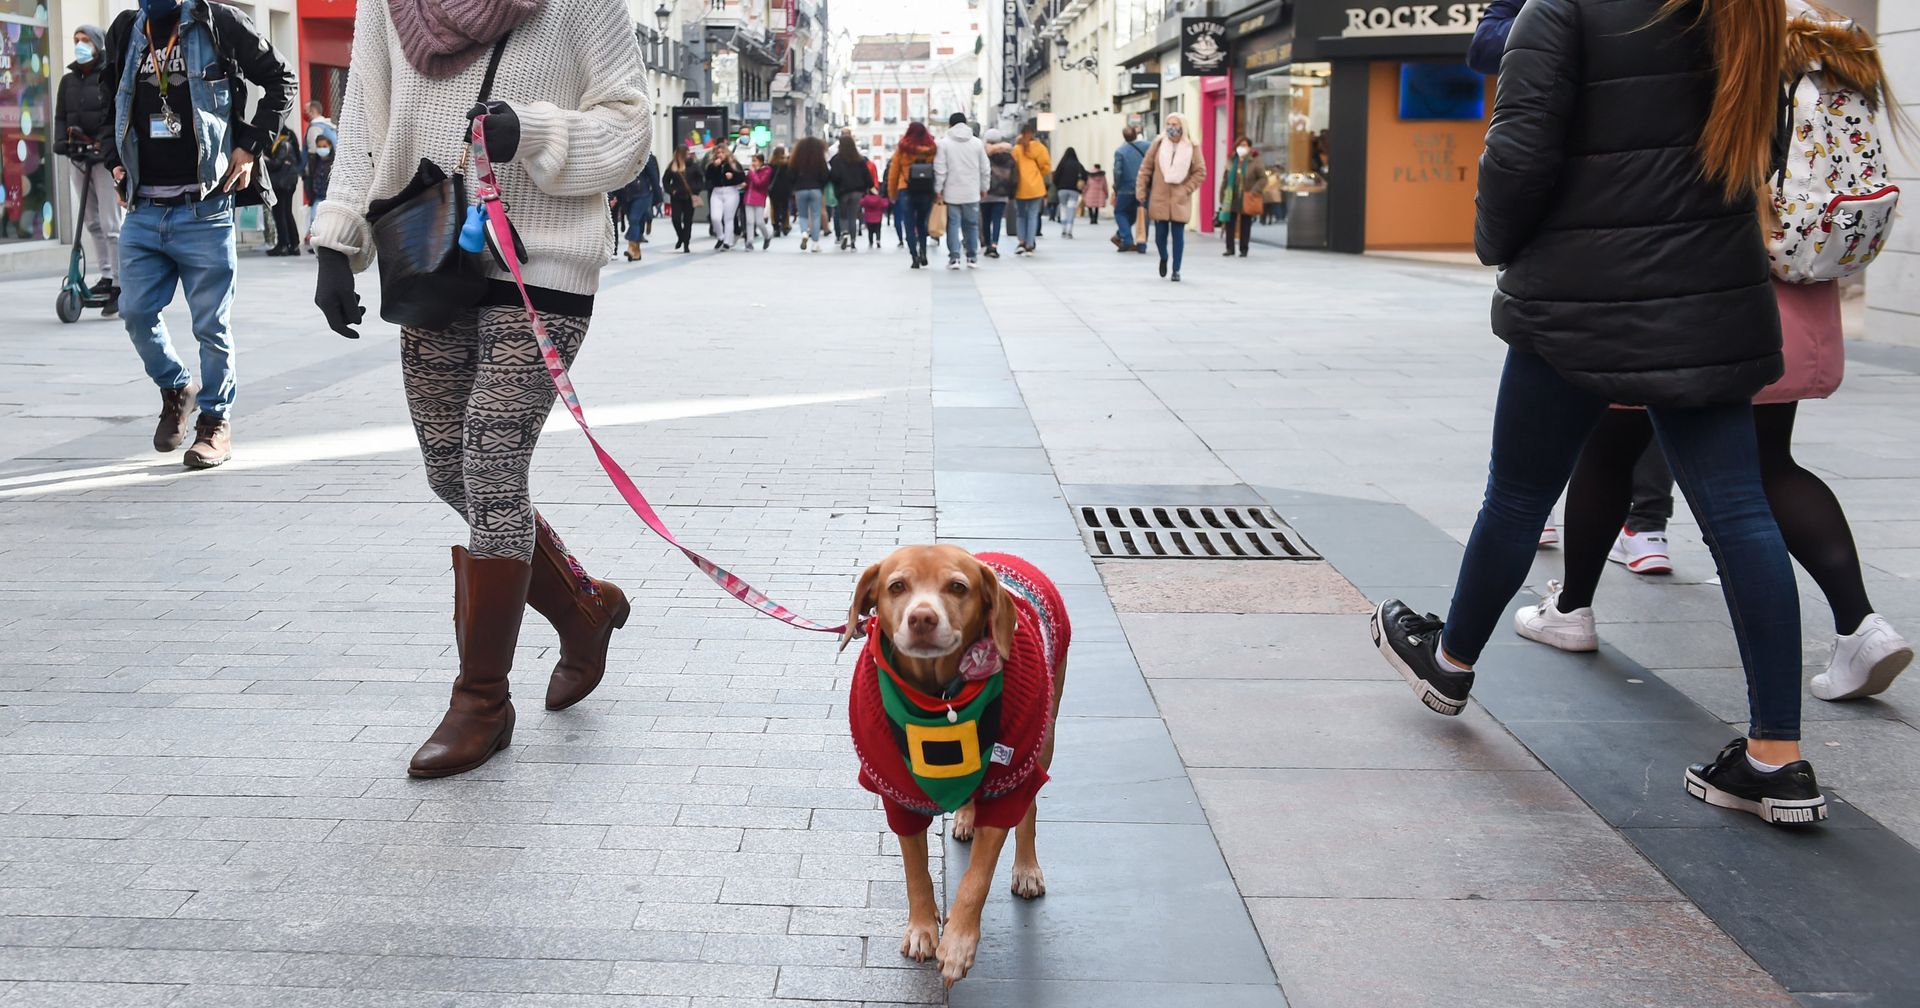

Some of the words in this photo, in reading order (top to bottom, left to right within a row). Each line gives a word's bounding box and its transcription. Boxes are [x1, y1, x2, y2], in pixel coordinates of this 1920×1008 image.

[1345, 5, 1440, 30] ROCK
[1447, 3, 1492, 28] SH
[146, 45, 181, 64] ARCTI
[1773, 807, 1813, 823] PUMA
